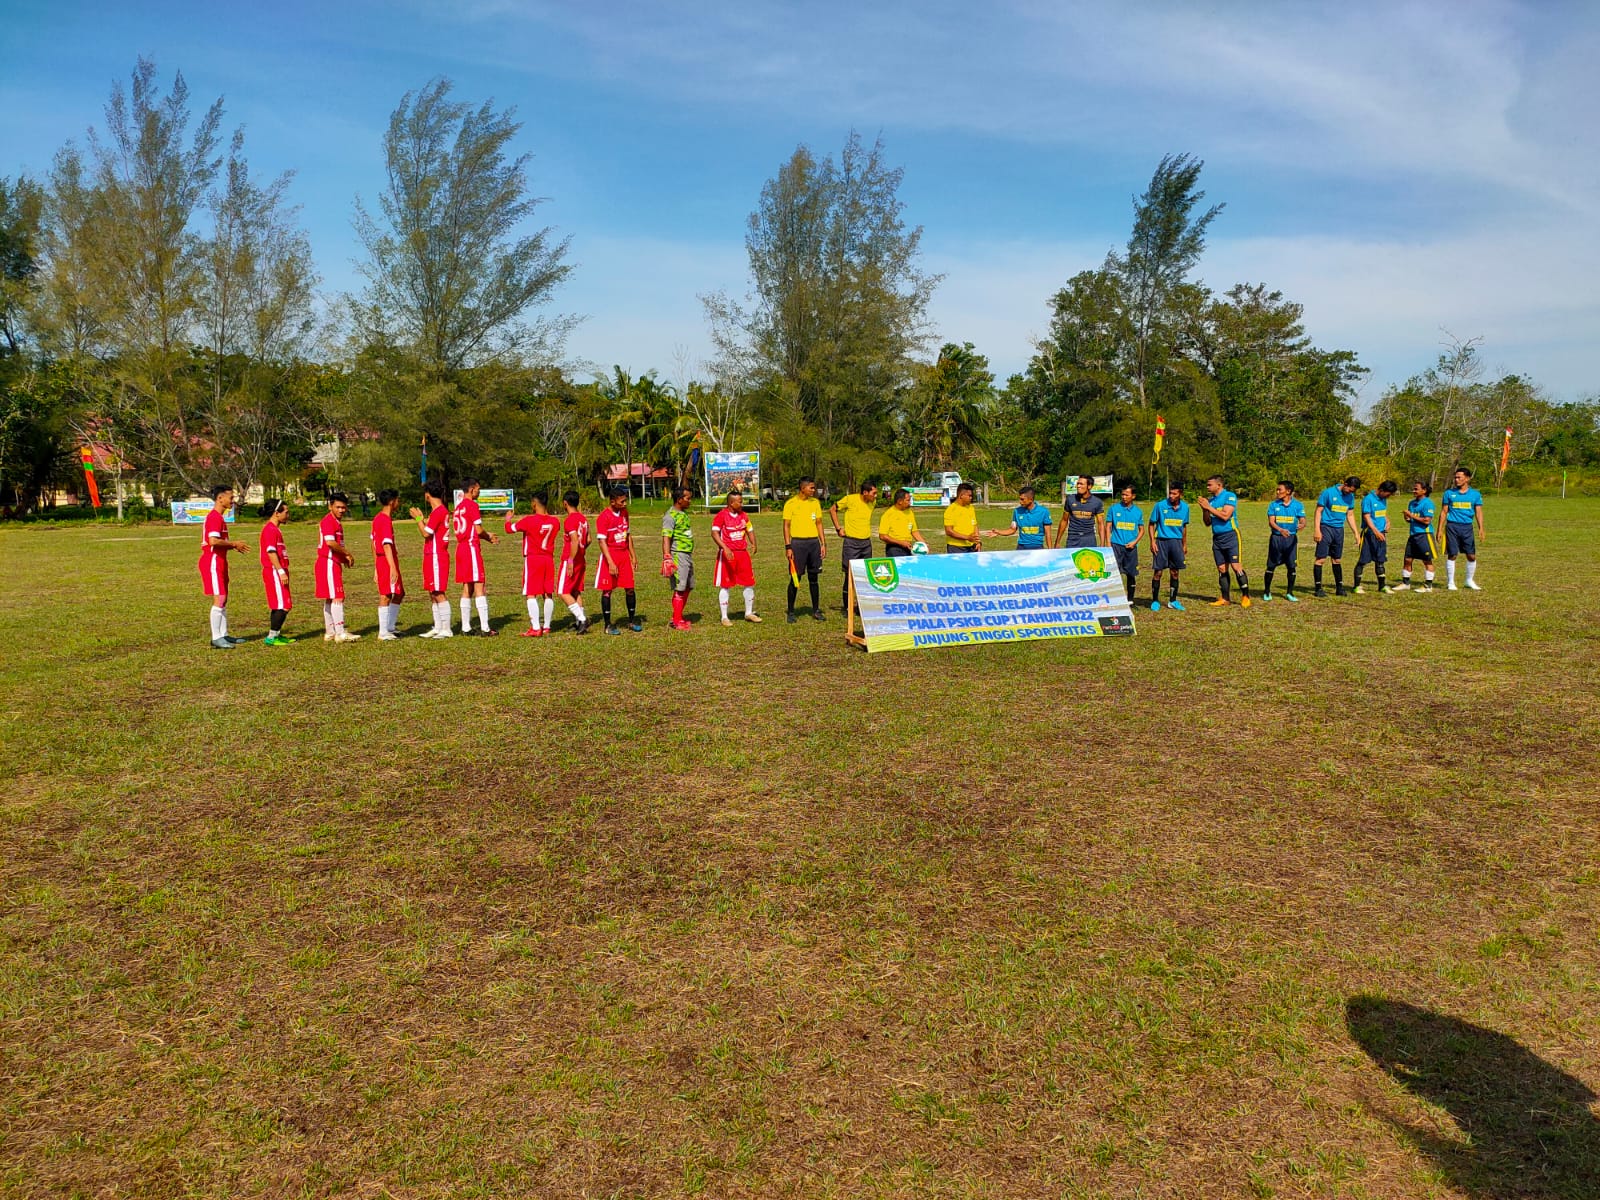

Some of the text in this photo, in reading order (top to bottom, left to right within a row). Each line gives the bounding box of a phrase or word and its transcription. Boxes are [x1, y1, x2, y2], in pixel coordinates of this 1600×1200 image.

[539, 523, 554, 551] 7
[937, 582, 1049, 598] OPEN TURNAMENT
[883, 594, 1110, 615] SEPAK BOLA DESA KELAPAPATI CUP 1
[907, 618, 946, 630] PIALA
[947, 616, 983, 628] PSKB
[983, 615, 1010, 627] CUP
[1018, 612, 1063, 624] TAHUN
[1065, 610, 1095, 622] 2022
[913, 632, 970, 647] JUNJUNG
[970, 629, 1015, 642] TINGGI
[1017, 625, 1097, 639] SPORTIFITAS
